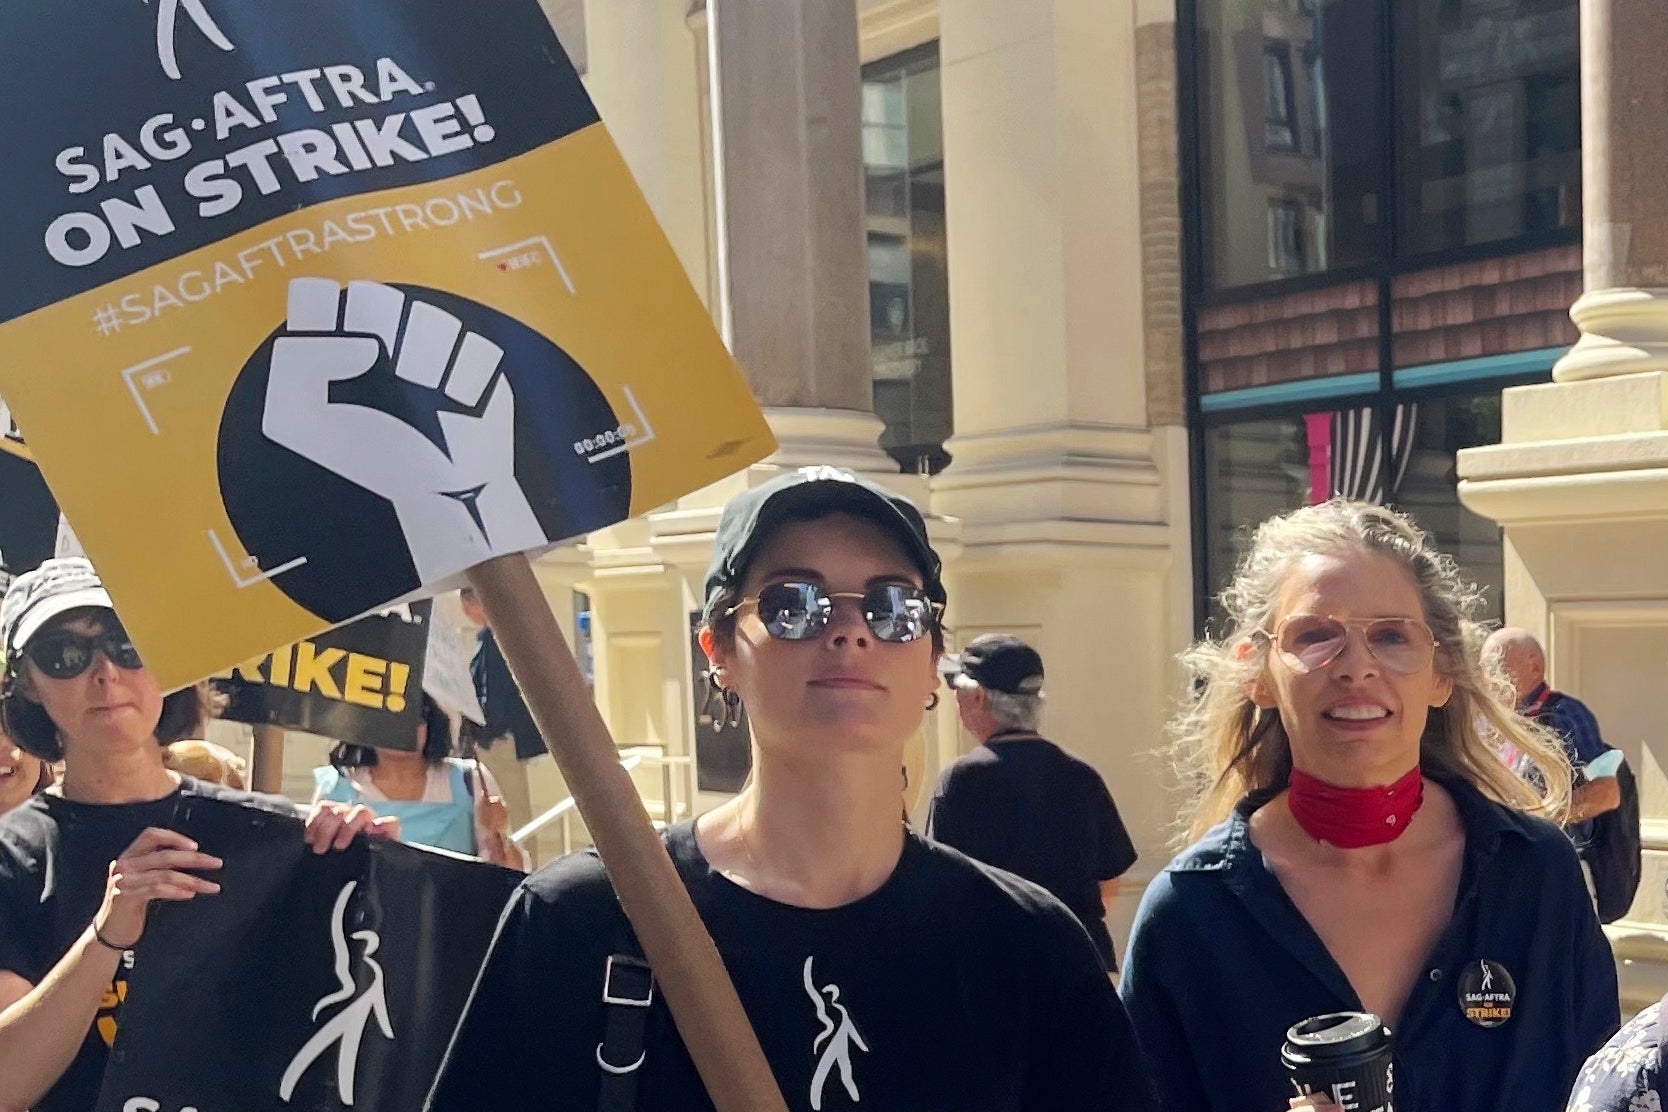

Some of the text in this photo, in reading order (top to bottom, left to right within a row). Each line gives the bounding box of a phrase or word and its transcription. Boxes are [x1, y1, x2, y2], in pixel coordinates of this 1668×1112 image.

[45, 94, 495, 266] ON STRIKE!
[92, 179, 522, 336] #SAGAFTRASTRONG
